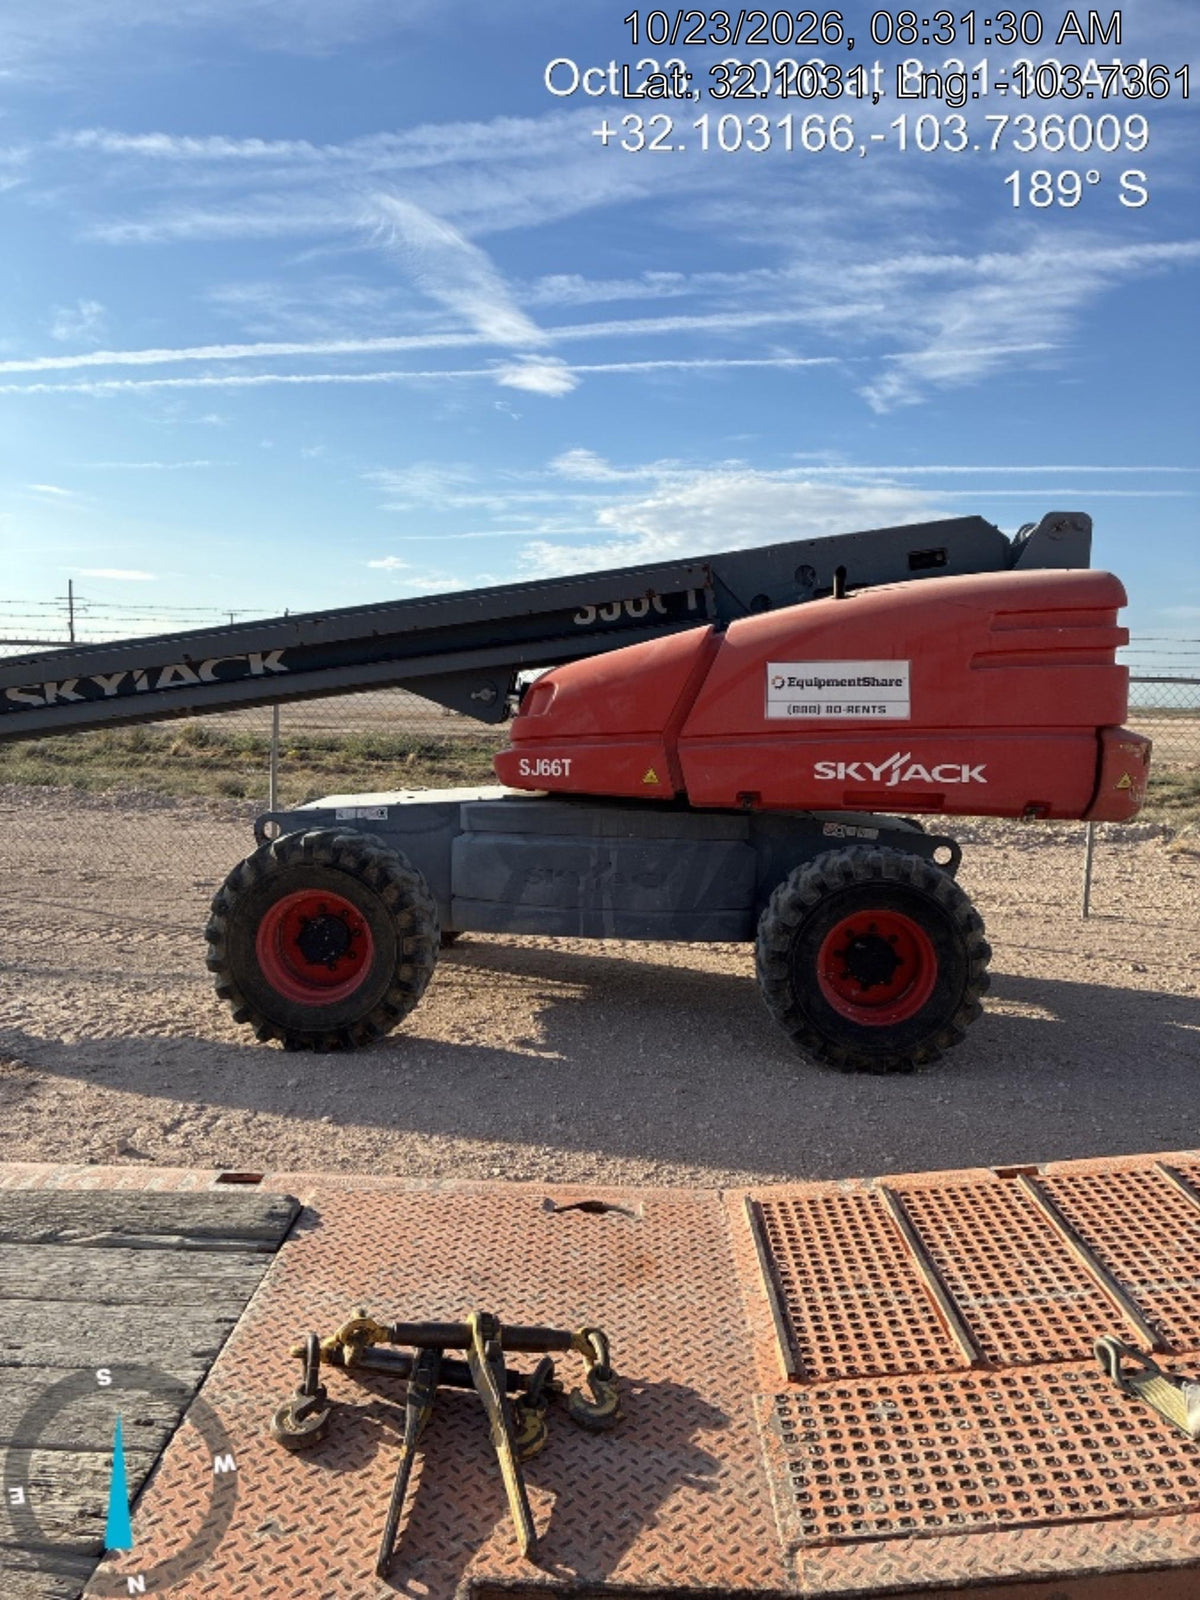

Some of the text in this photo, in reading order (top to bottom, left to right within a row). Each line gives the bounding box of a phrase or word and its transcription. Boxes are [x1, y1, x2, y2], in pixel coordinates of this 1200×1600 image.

[787, 676, 903, 690] EquipmentShare
[519, 758, 572, 777] SJ66T
[813, 751, 988, 787] SKYJACK
